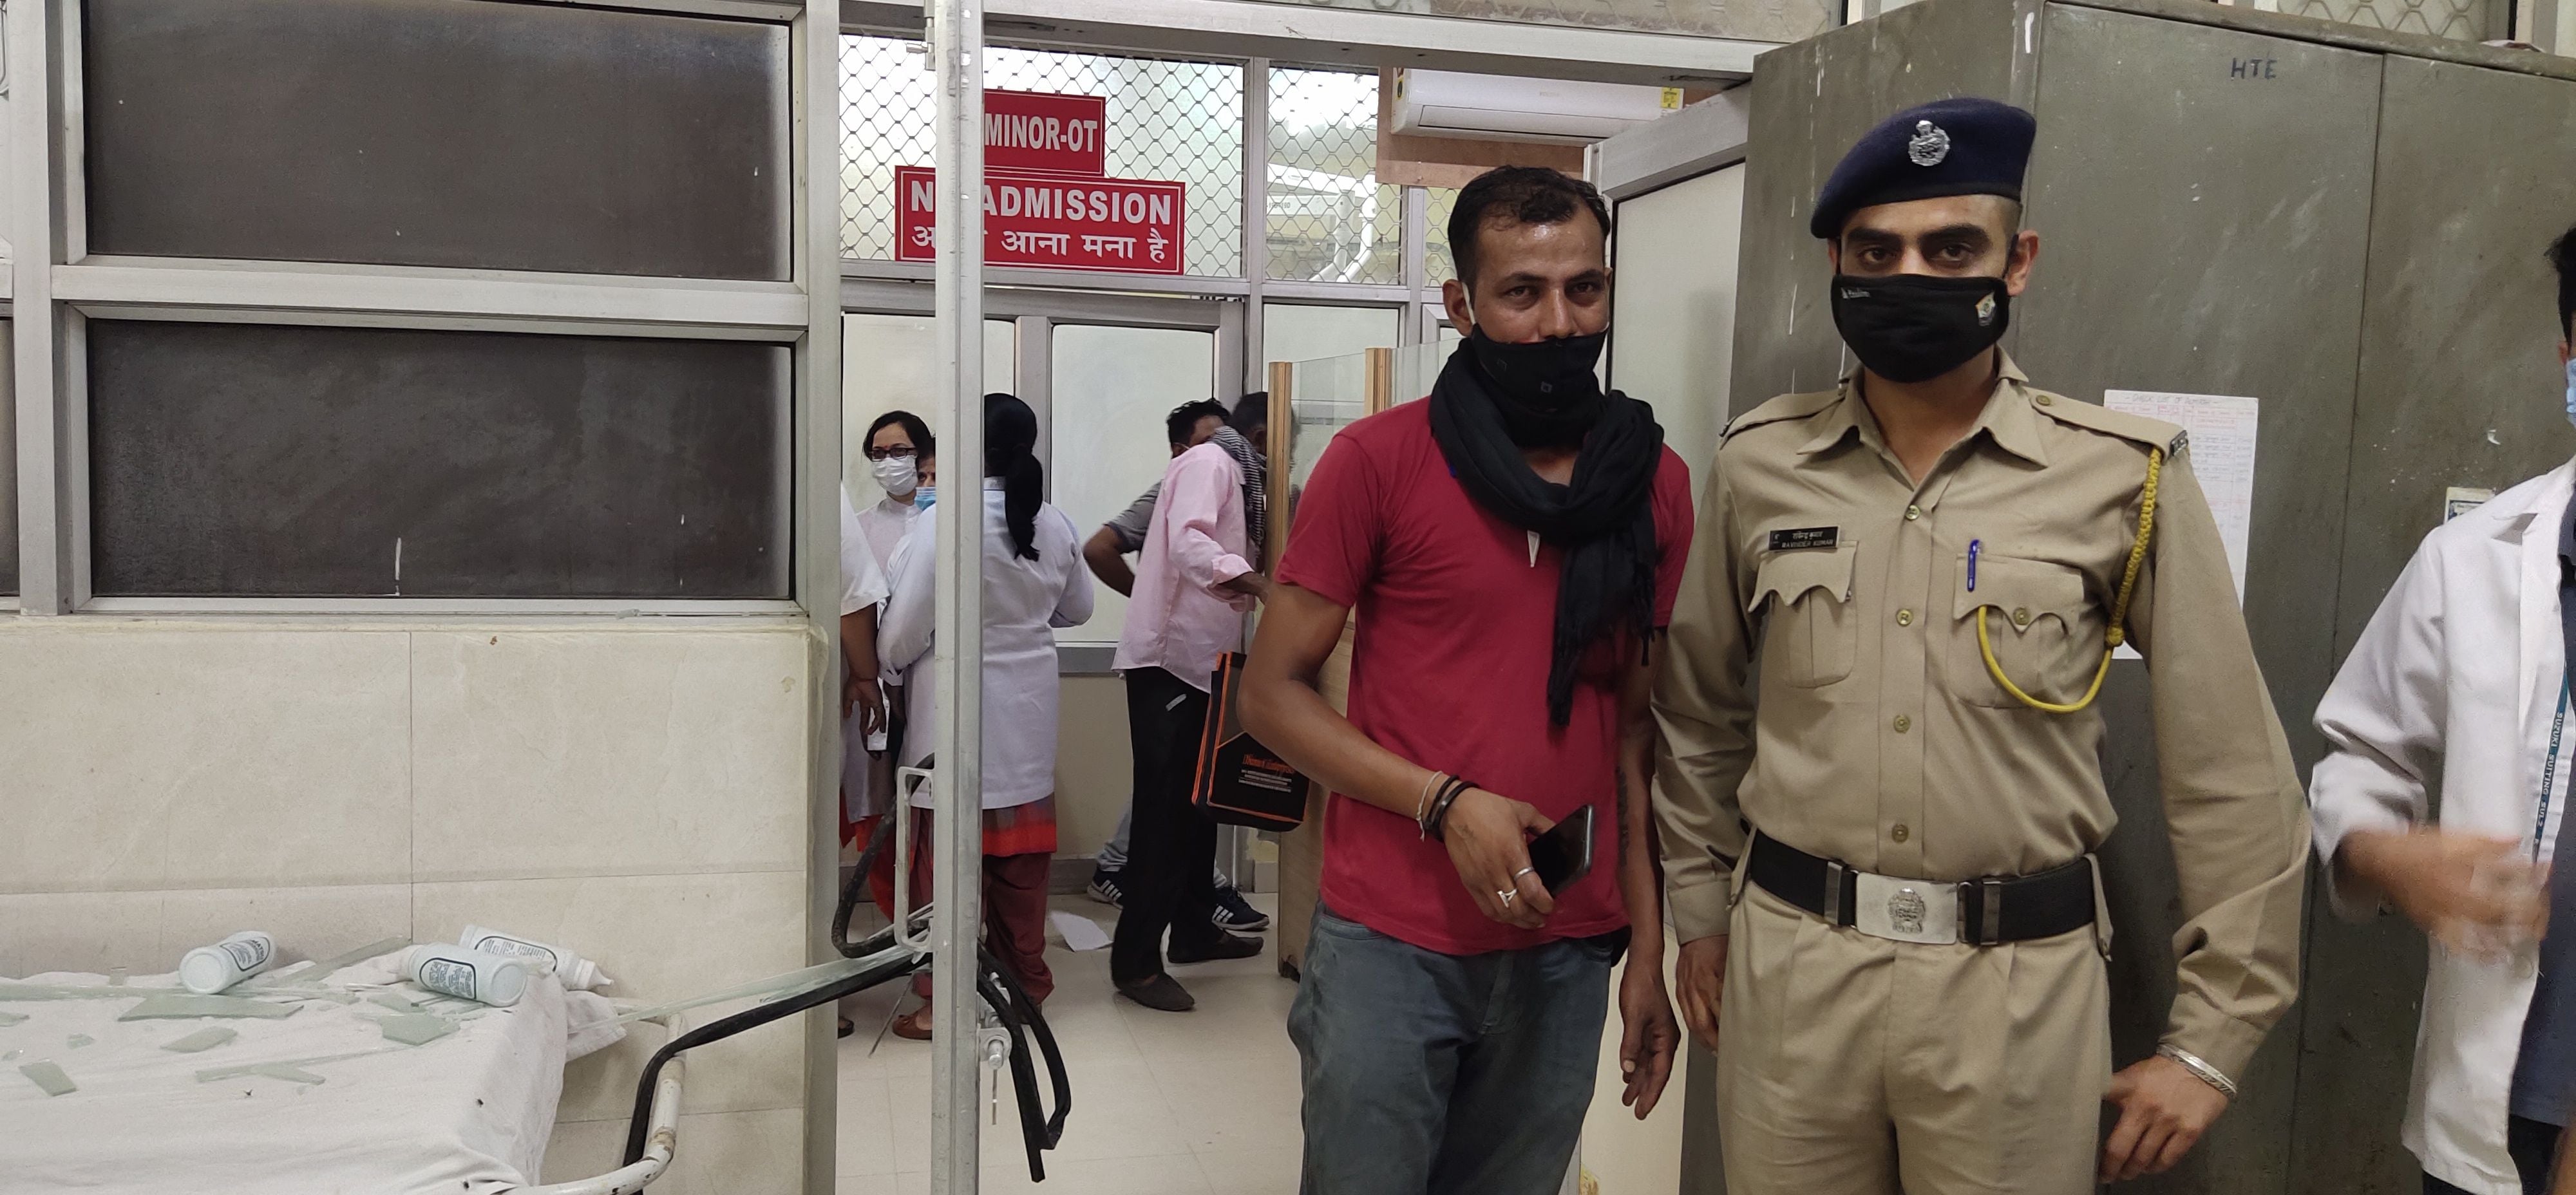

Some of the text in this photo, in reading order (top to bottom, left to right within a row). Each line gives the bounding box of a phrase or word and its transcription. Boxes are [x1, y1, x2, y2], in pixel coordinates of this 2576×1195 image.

[2231, 57, 2278, 80] HTE
[985, 113, 1098, 153] MINOR-OT
[911, 180, 1171, 225] N ADMISSION
[1001, 227, 1169, 263] आना मना है
[2551, 712, 2563, 748] SUZUKI
[2543, 753, 2555, 795] SUITING
